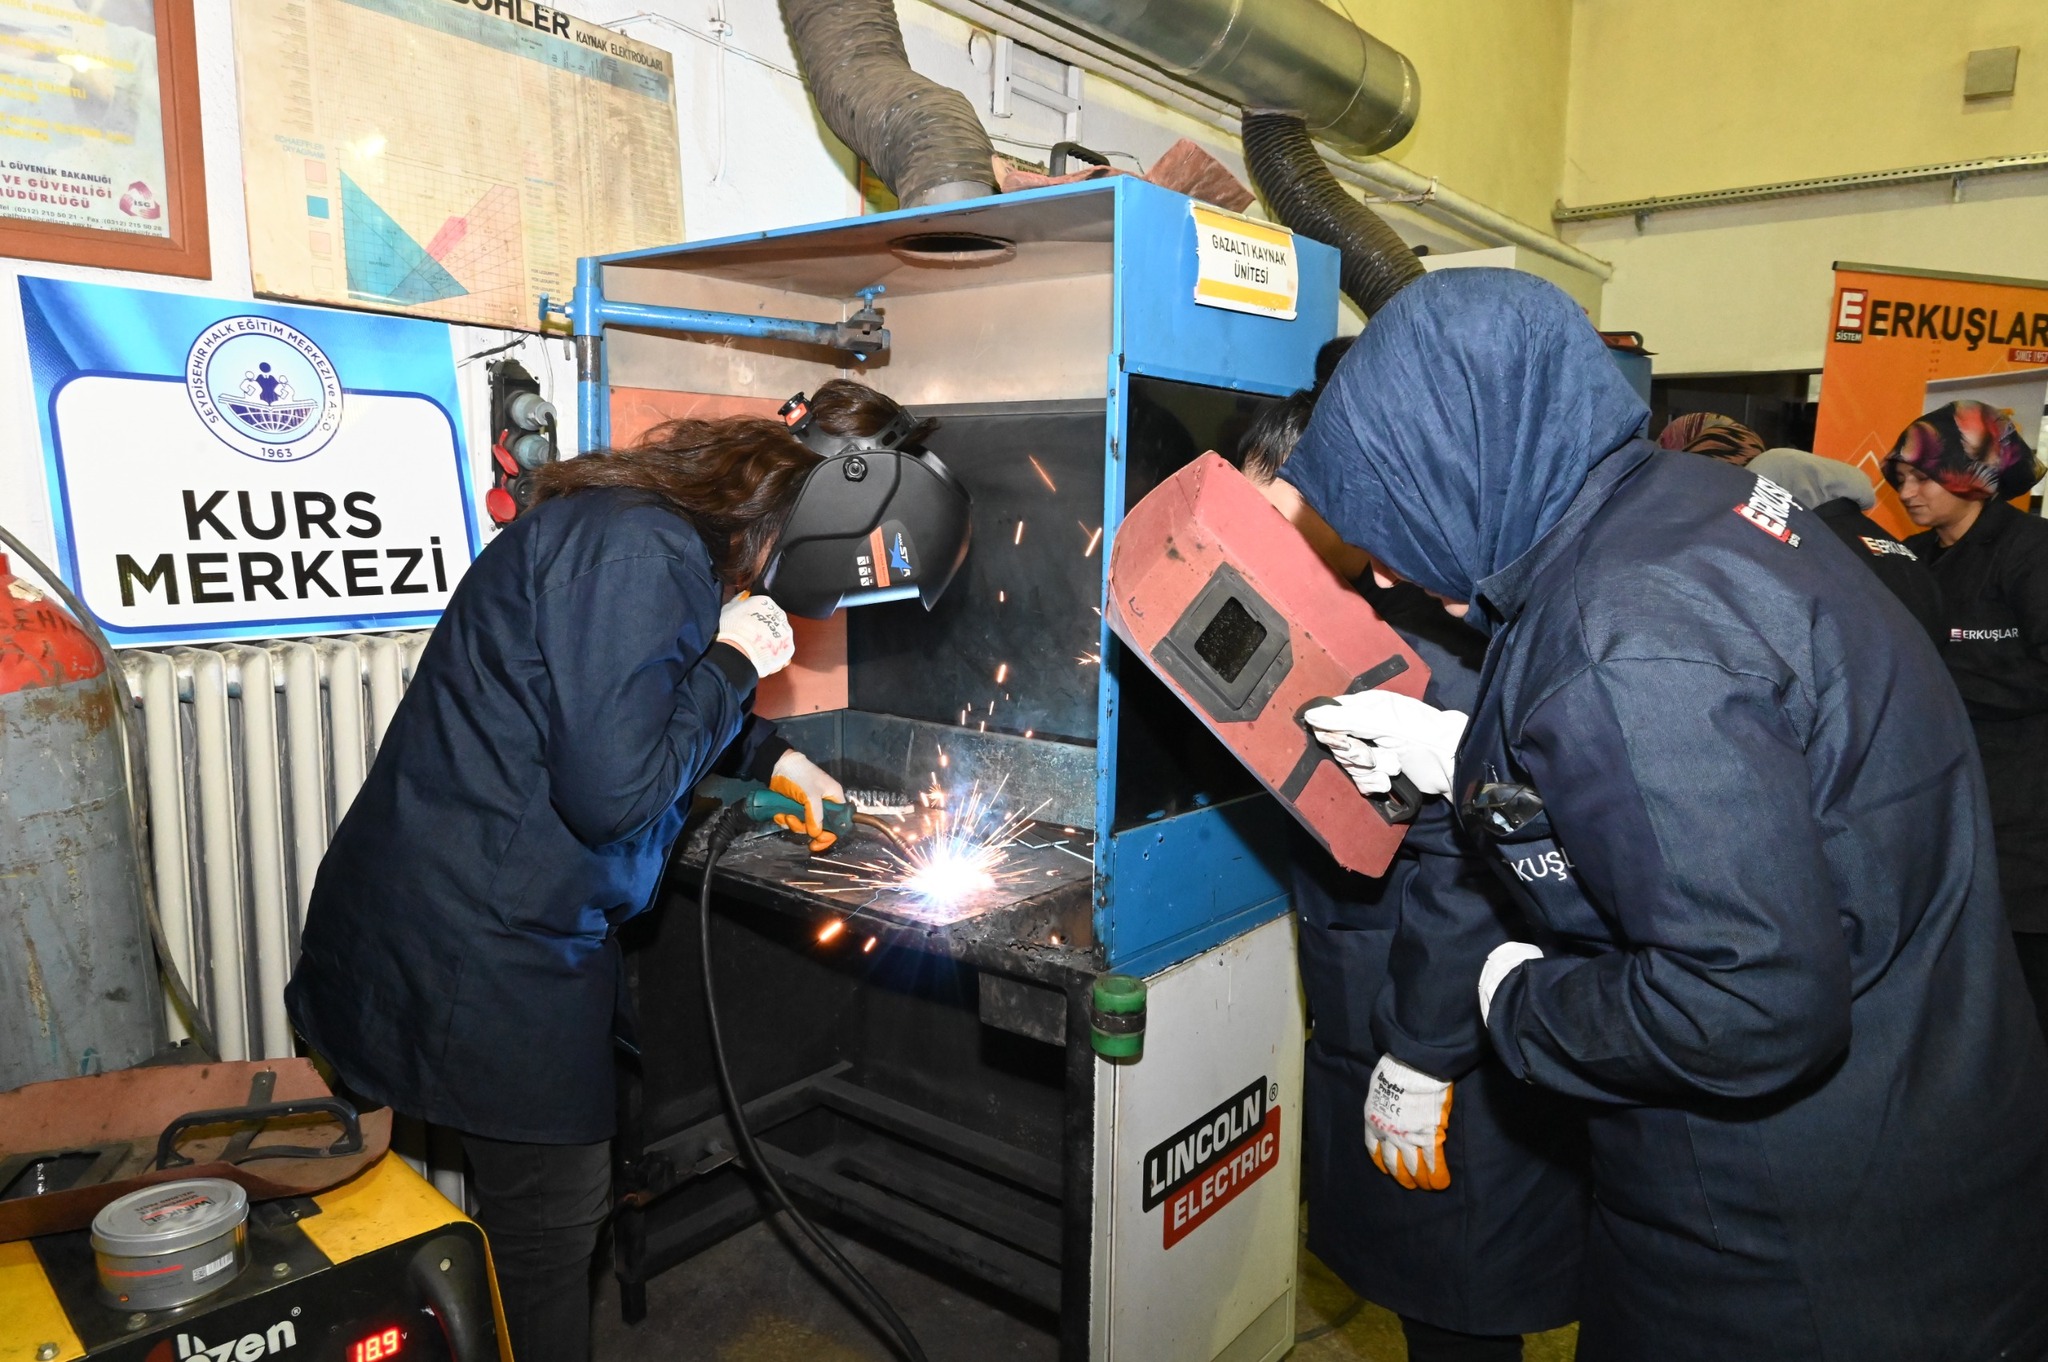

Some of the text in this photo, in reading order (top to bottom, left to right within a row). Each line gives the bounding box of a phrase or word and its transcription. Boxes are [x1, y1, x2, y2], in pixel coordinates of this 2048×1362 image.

[454, 0, 571, 39] HLER
[576, 30, 608, 52] KAYNAK
[611, 43, 664, 72] ELEKTRODLARI
[2, 174, 112, 199] VE GÜVENLİĞİ
[9, 161, 57, 176] GÜVENLİK
[61, 169, 112, 185] BAKANLIĞI
[1212, 234, 1287, 267] GAZALTI KAYNAK
[1234, 259, 1269, 285] ÜNİTESİ
[203, 324, 236, 348] HALK
[237, 318, 284, 336] EĞİTİM
[1835, 330, 1862, 342] SİSTEM
[1868, 300, 2048, 351] ERKUŞLAR
[287, 332, 334, 381] MERKEZİ
[191, 347, 219, 424] SEYDİŞEHİR
[261, 447, 293, 458] 1963
[181, 489, 383, 541] KURS
[115, 536, 448, 607] MERKEZİ
[1963, 628, 2018, 642] ERKUŞLAR
[1378, 1071, 1404, 1095] Beybi
[1151, 1090, 1261, 1198] LINCOLN
[1174, 1133, 1273, 1231] ELECTRIC
[357, 1330, 397, 1362] 18.9
